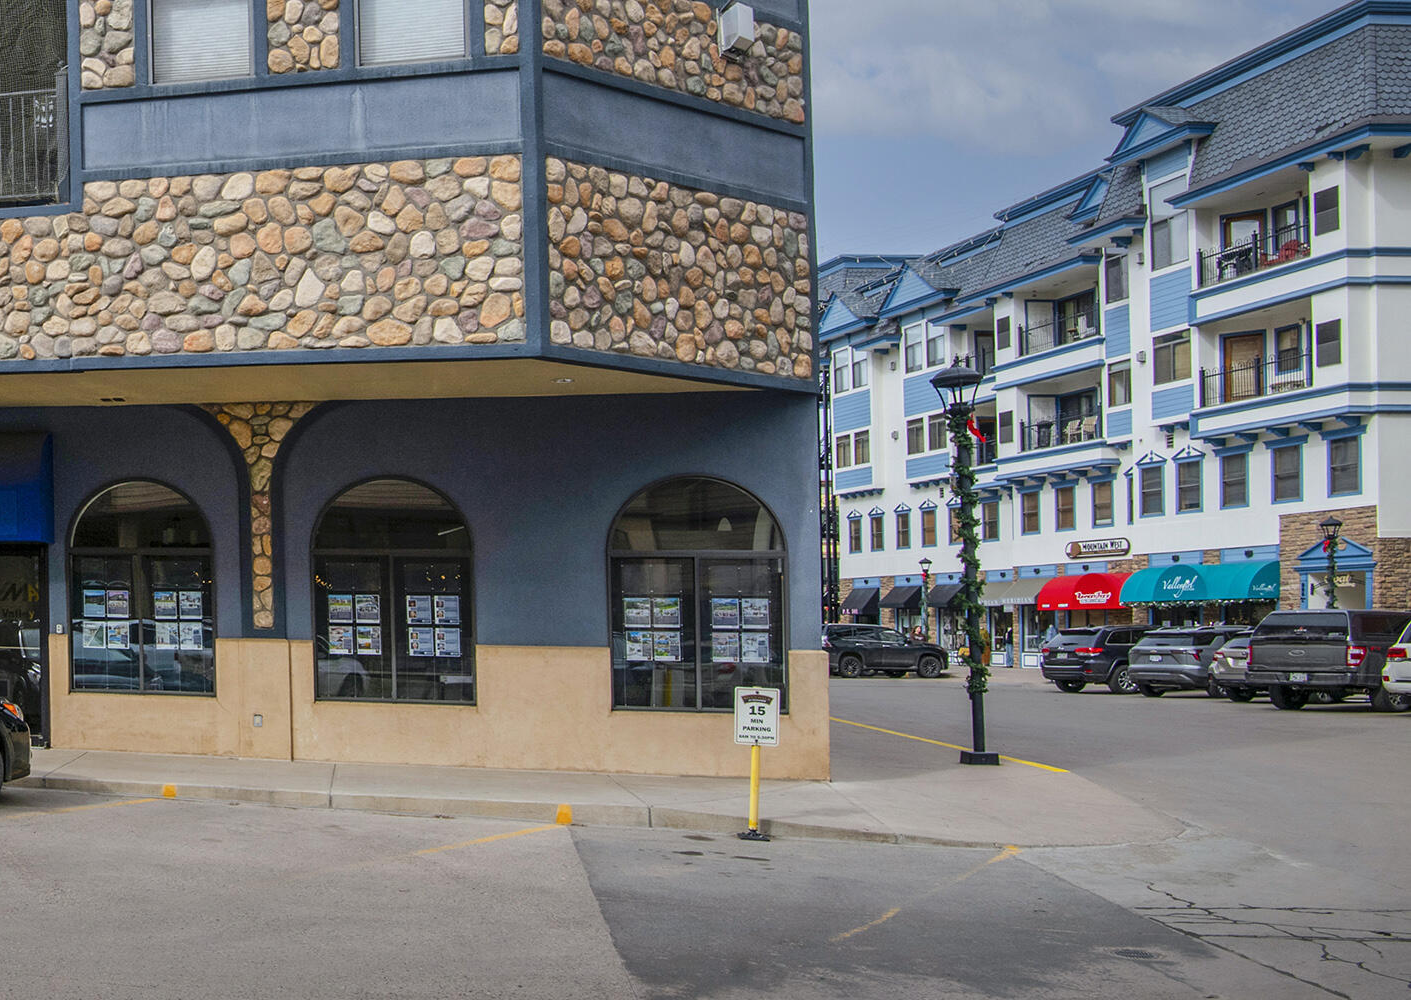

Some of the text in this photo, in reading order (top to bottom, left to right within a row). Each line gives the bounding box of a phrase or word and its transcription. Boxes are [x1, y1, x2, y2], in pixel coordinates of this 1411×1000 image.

[1082, 540, 1122, 551] MOUNTAIN WEST
[749, 705, 766, 716] 15
